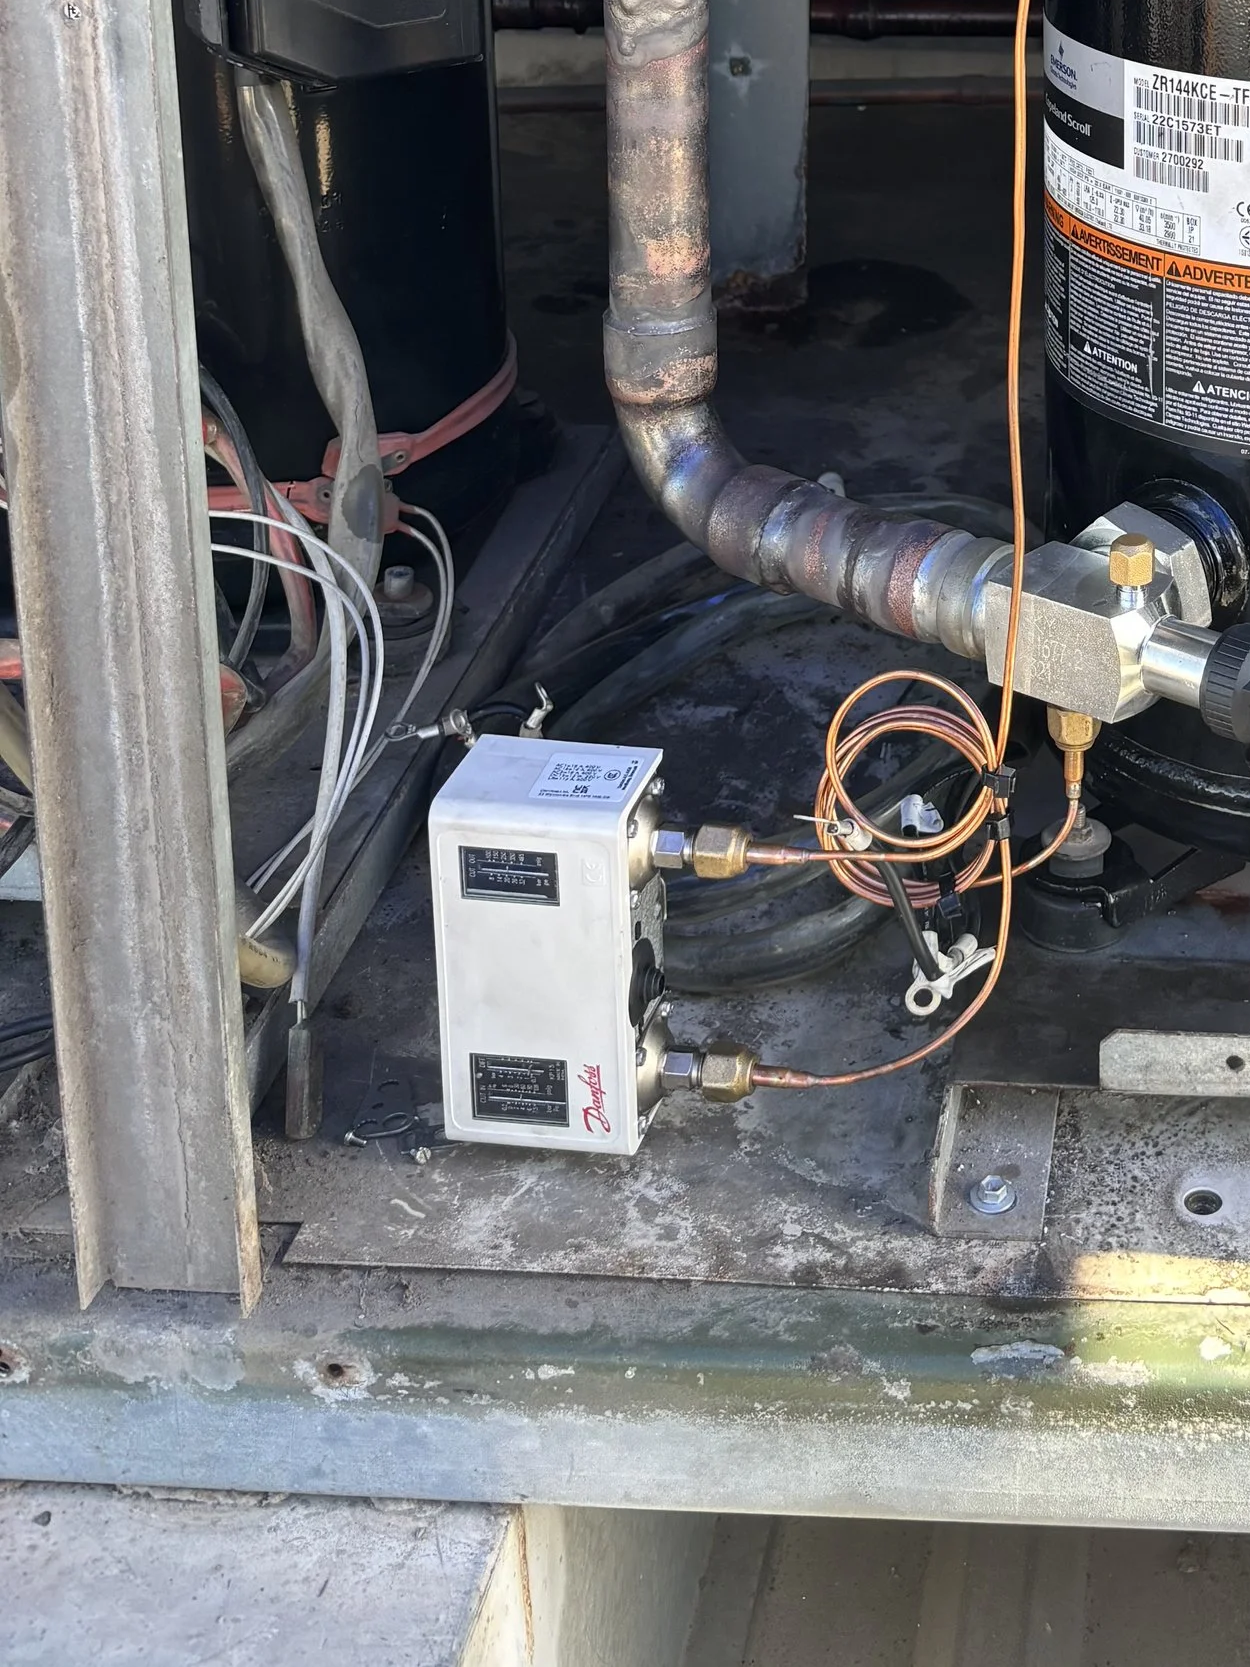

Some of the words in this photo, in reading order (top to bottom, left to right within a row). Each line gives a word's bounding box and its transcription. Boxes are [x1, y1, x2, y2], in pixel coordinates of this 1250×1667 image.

[1133, 77, 1150, 88] MODEL
[1067, 114, 1091, 137] Scroll
[1133, 111, 1150, 122] SERIAL
[1151, 114, 1222, 136] 22C1573ET
[1133, 147, 1160, 160] CUSTOMER
[1161, 152, 1204, 170] 2700292
[1187, 217, 1198, 227] BOX
[1080, 230, 1163, 272] AVERTISSEMENT
[1092, 346, 1138, 374] ATTENTION
[577, 1063, 612, 1134] Danfoss
